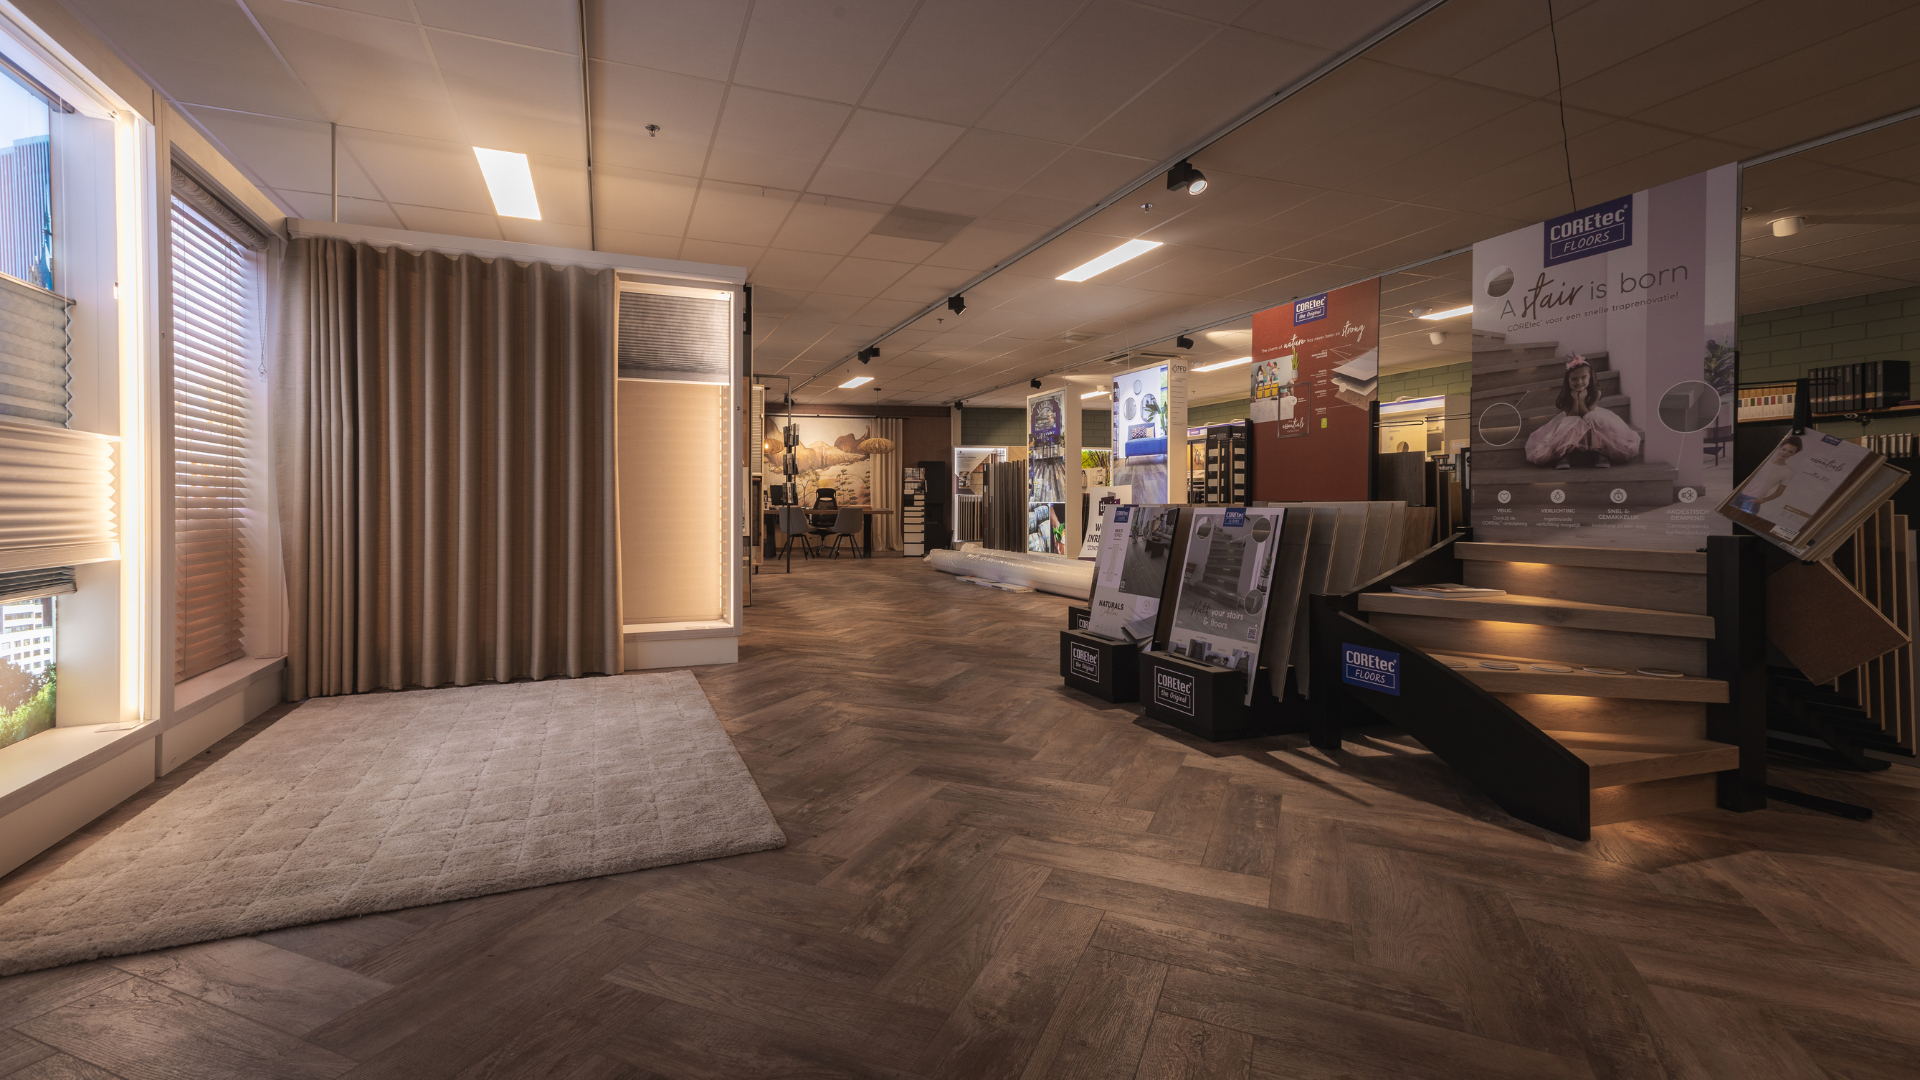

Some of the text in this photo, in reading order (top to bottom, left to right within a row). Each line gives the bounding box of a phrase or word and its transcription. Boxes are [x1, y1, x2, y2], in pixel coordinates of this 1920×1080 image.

[1563, 231, 1610, 253] FLOORS
[1500, 265, 1688, 320] A stair is born
[1545, 316, 1563, 325] voor
[1566, 312, 1581, 321] een
[1584, 306, 1608, 318] snelle
[1612, 291, 1679, 312] traprenovatie!
[1342, 320, 1365, 343] strong
[1098, 599, 1124, 610] NATURALS
[1211, 609, 1225, 619] your
[1226, 610, 1244, 621] stairs
[1202, 617, 1228, 630] & floors
[1355, 669, 1385, 684] FLOORS
[1160, 689, 1187, 703] the Original
